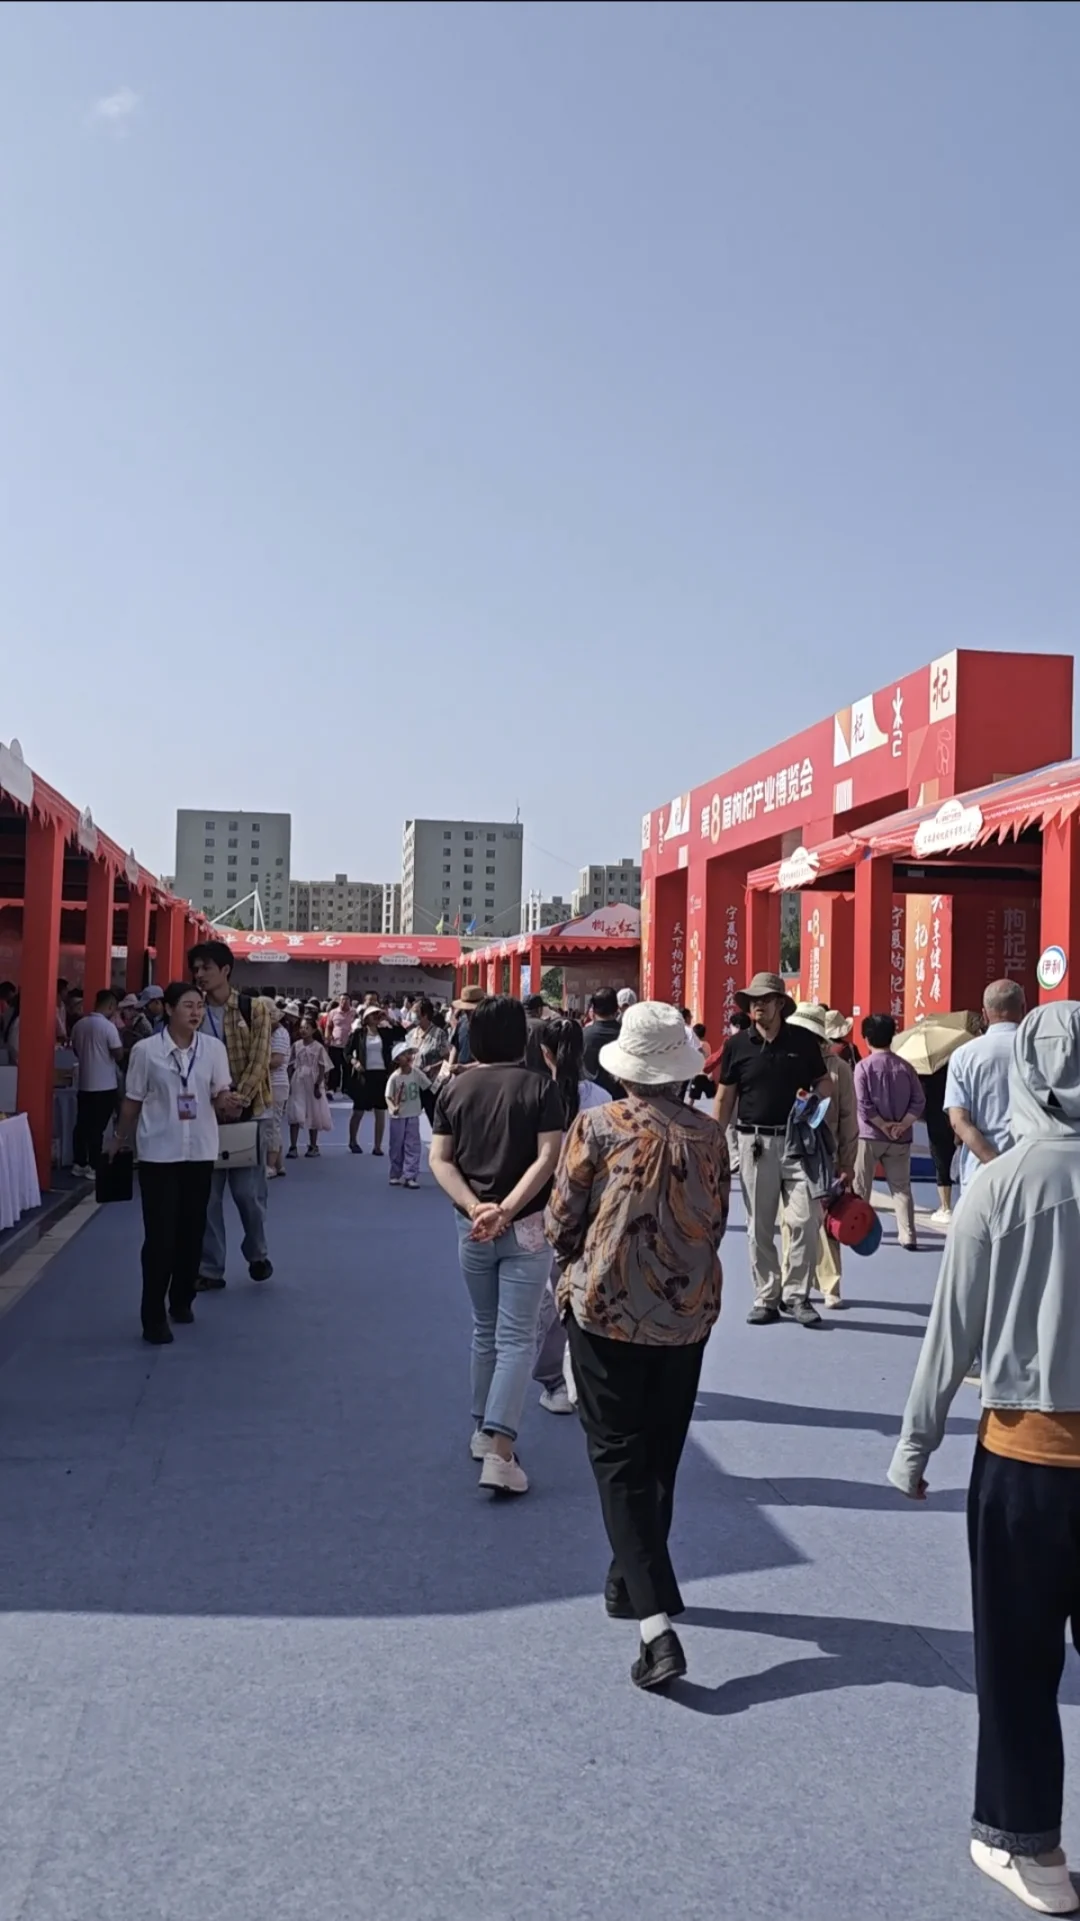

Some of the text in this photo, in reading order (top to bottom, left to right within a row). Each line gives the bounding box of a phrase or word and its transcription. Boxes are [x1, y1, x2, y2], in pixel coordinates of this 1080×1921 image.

[700, 757, 813, 845] 第8届枸杞产业博览会
[671, 922, 684, 1004] 天下枸杞看宁
[724, 906, 738, 965] 宁夏枸杞
[1042, 959, 1061, 976] 伊利
